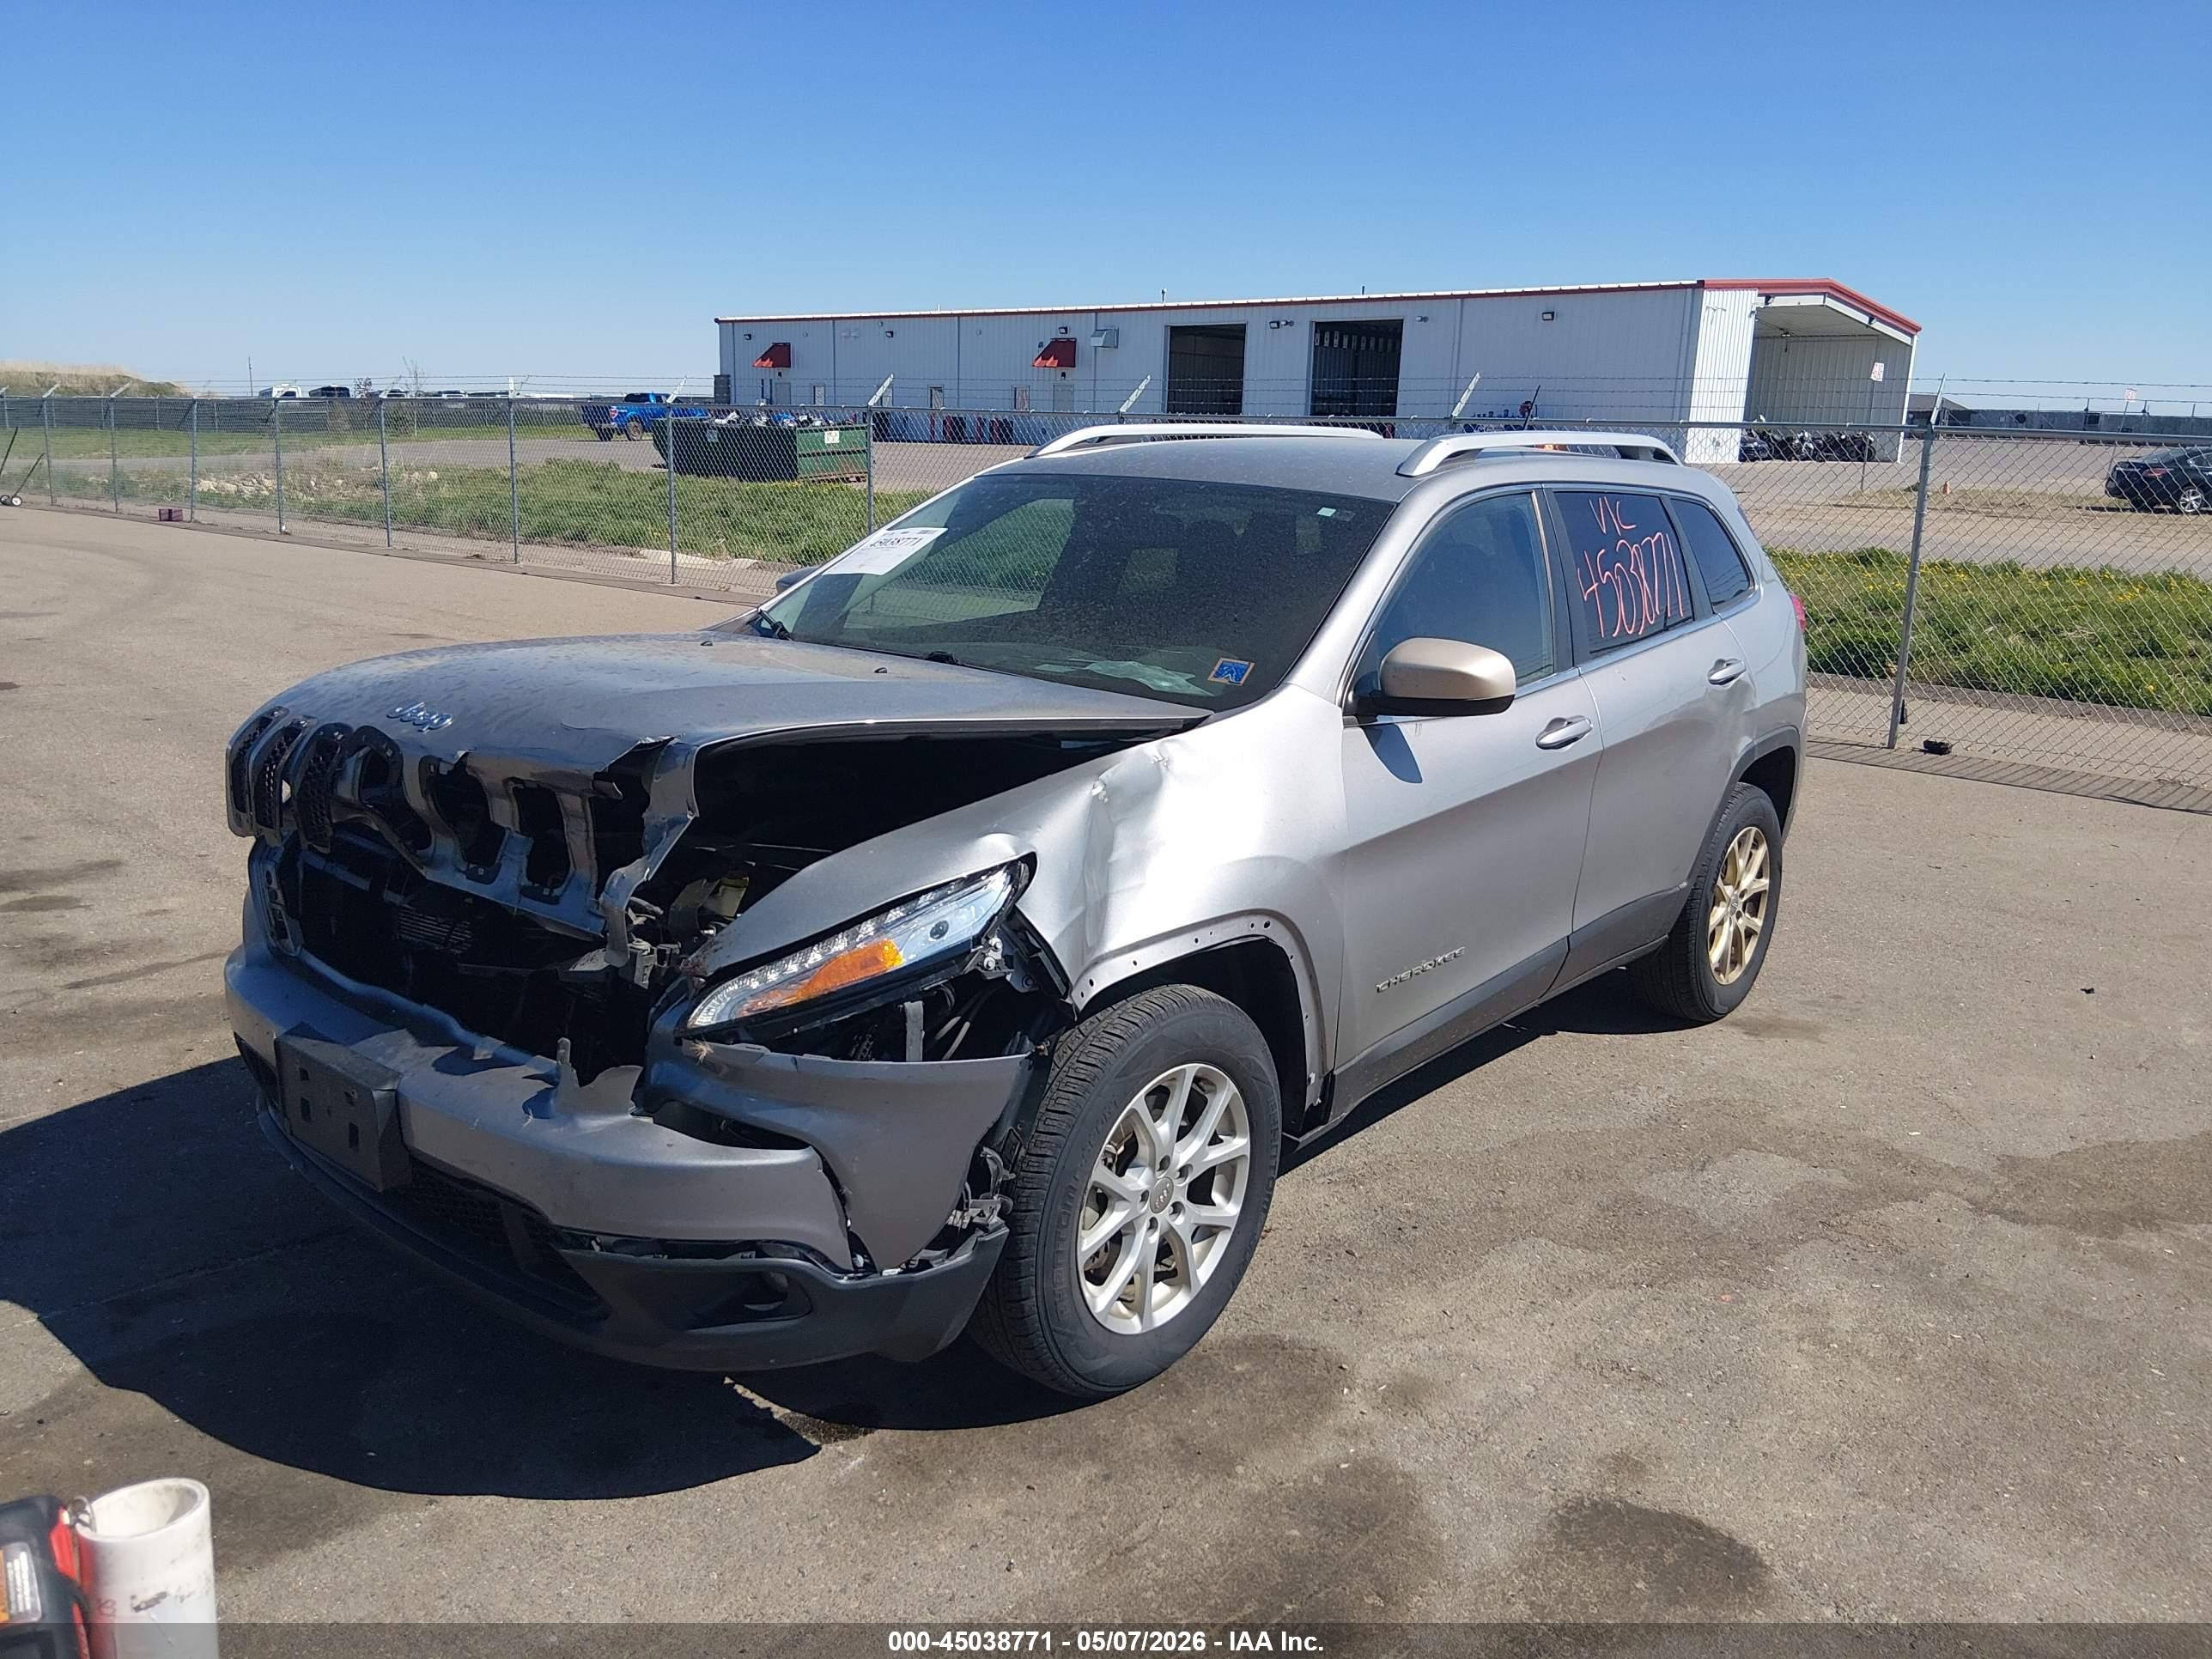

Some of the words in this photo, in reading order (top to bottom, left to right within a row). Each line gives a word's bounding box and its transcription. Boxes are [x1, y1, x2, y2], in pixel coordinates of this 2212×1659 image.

[1577, 532, 1685, 638] 45038771
[386, 702, 453, 733] Jeep
[1376, 946, 1465, 993] CHEROKEE
